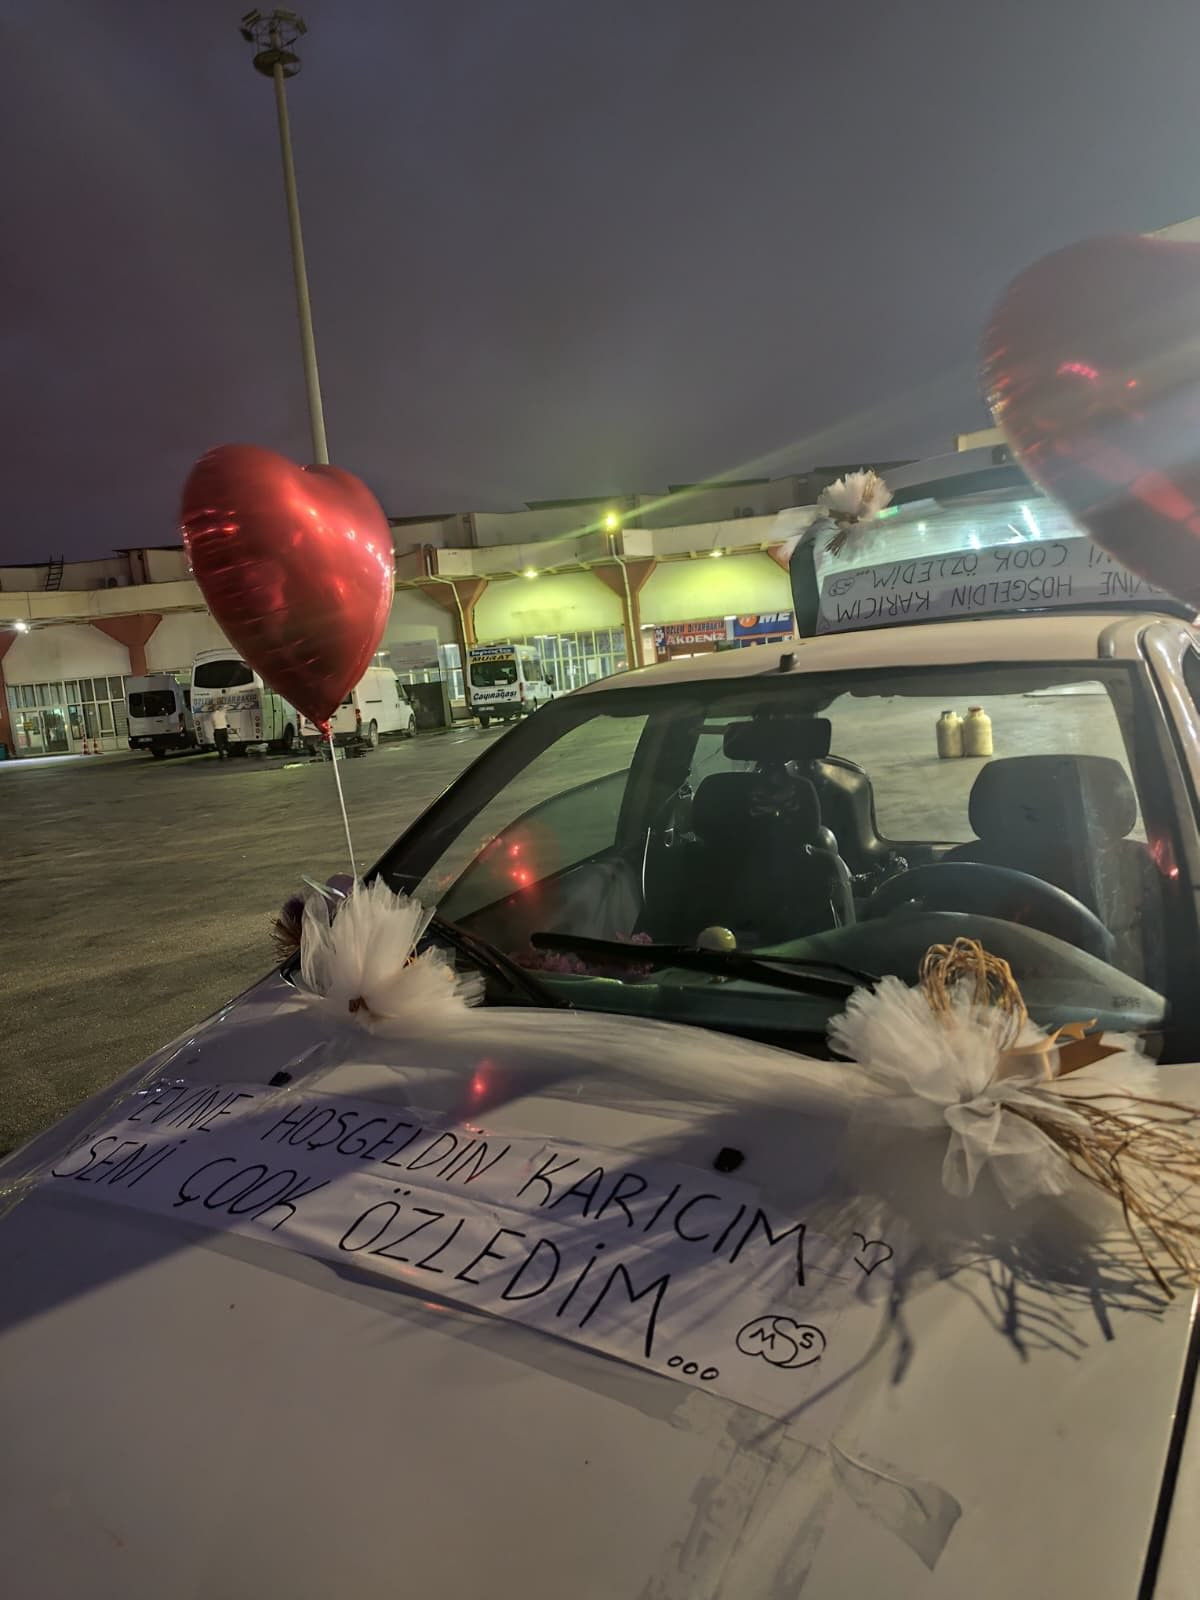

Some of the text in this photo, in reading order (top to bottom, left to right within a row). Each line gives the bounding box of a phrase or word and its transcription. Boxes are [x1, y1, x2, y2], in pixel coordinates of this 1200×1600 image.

[836, 589, 930, 624] KARICIM
[51, 1136, 187, 1188] SENİ
[172, 1156, 331, 1232] ÇOOK
[260, 1104, 512, 1185] HOŞGELDİN
[516, 1152, 807, 1287] KARICIM
